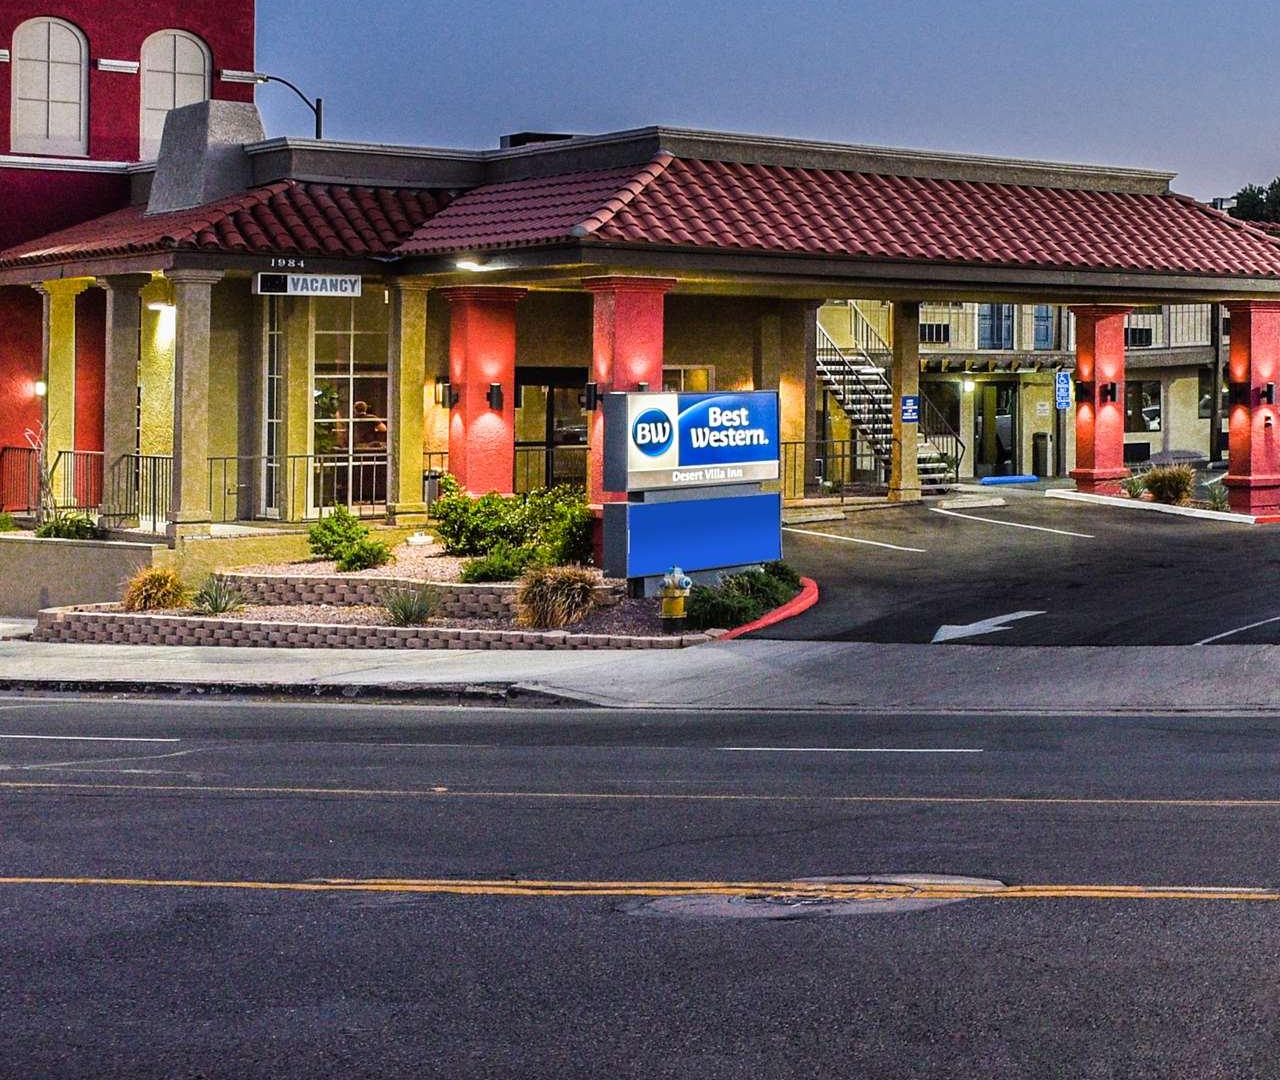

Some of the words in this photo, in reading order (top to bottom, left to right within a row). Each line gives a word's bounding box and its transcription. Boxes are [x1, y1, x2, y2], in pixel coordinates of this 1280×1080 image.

[271, 258, 304, 268] 1984
[291, 277, 357, 292] VACANCY
[709, 407, 749, 427] Best
[637, 422, 669, 444] BW
[672, 470, 703, 481] Desert
[704, 467, 725, 480] Villa
[727, 467, 743, 478] Inn
